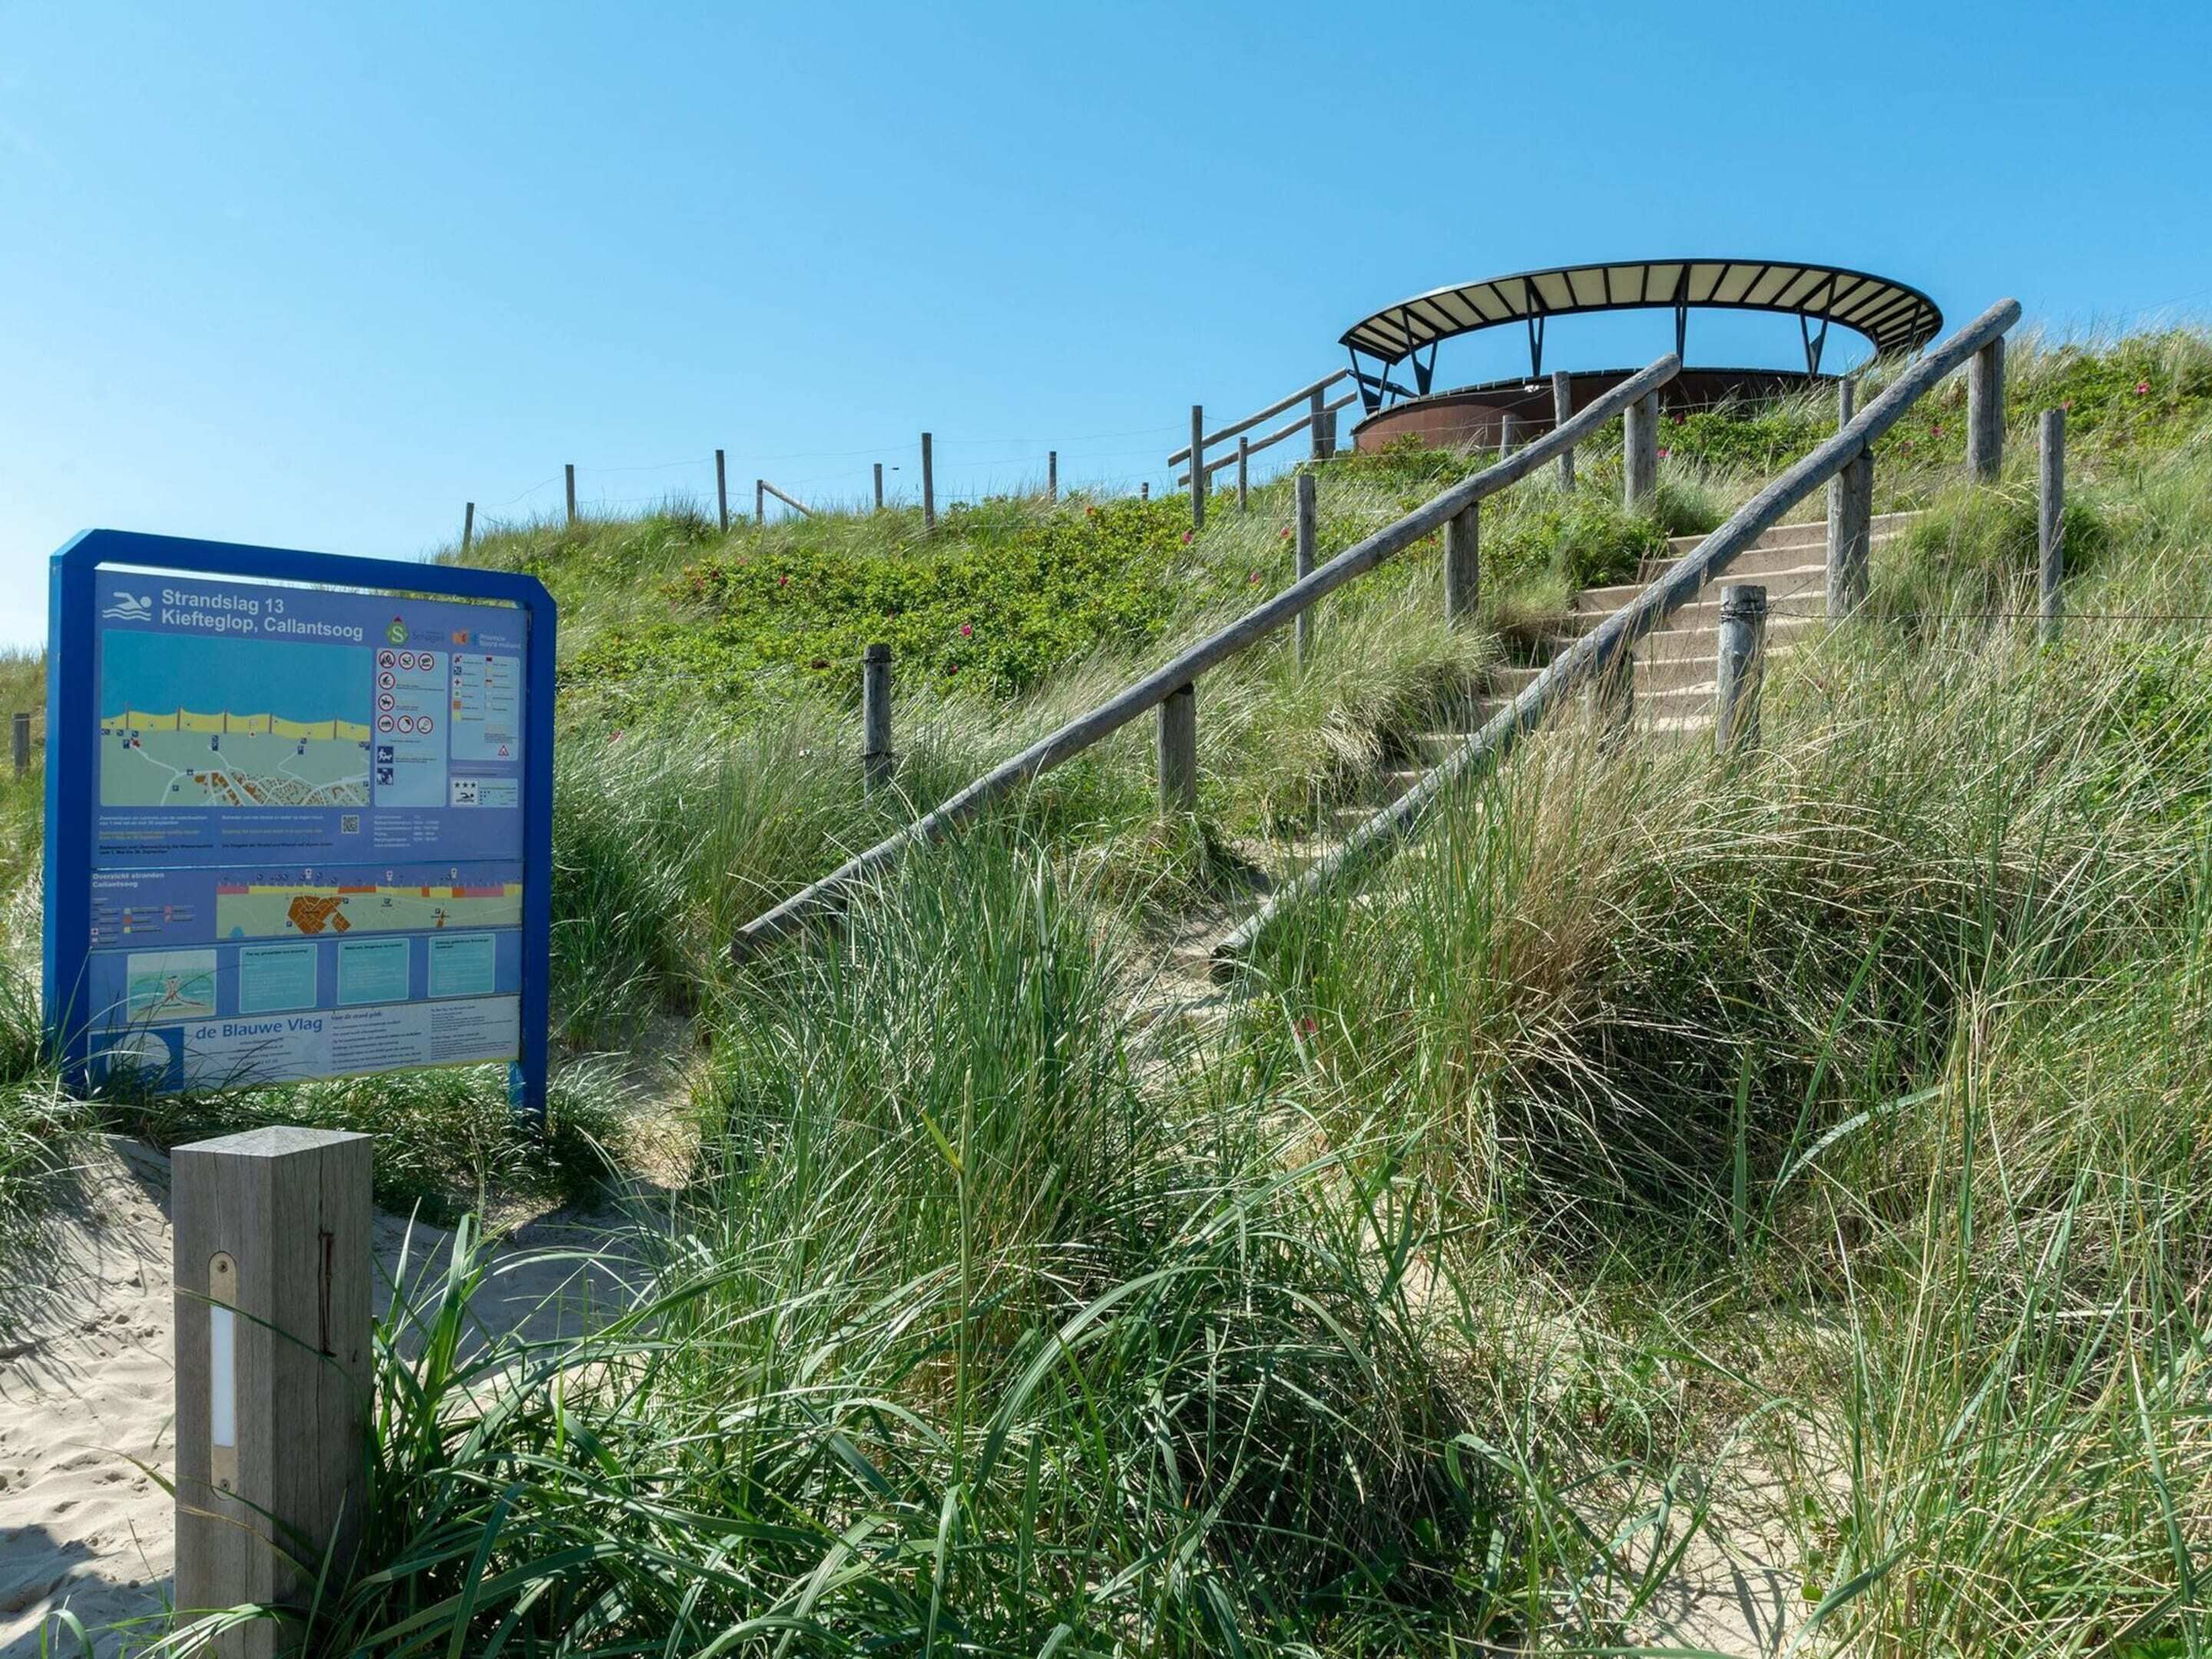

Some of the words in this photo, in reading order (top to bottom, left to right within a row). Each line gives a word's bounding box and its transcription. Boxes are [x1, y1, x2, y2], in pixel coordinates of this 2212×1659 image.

[162, 589, 259, 614] Strandslag
[265, 598, 284, 614] 13
[162, 608, 259, 633] Kiefteglop,
[263, 617, 363, 641] Callantsoog
[196, 1026, 217, 1040] de
[223, 1022, 283, 1037] Blauwe
[287, 1018, 323, 1032] Vlag
